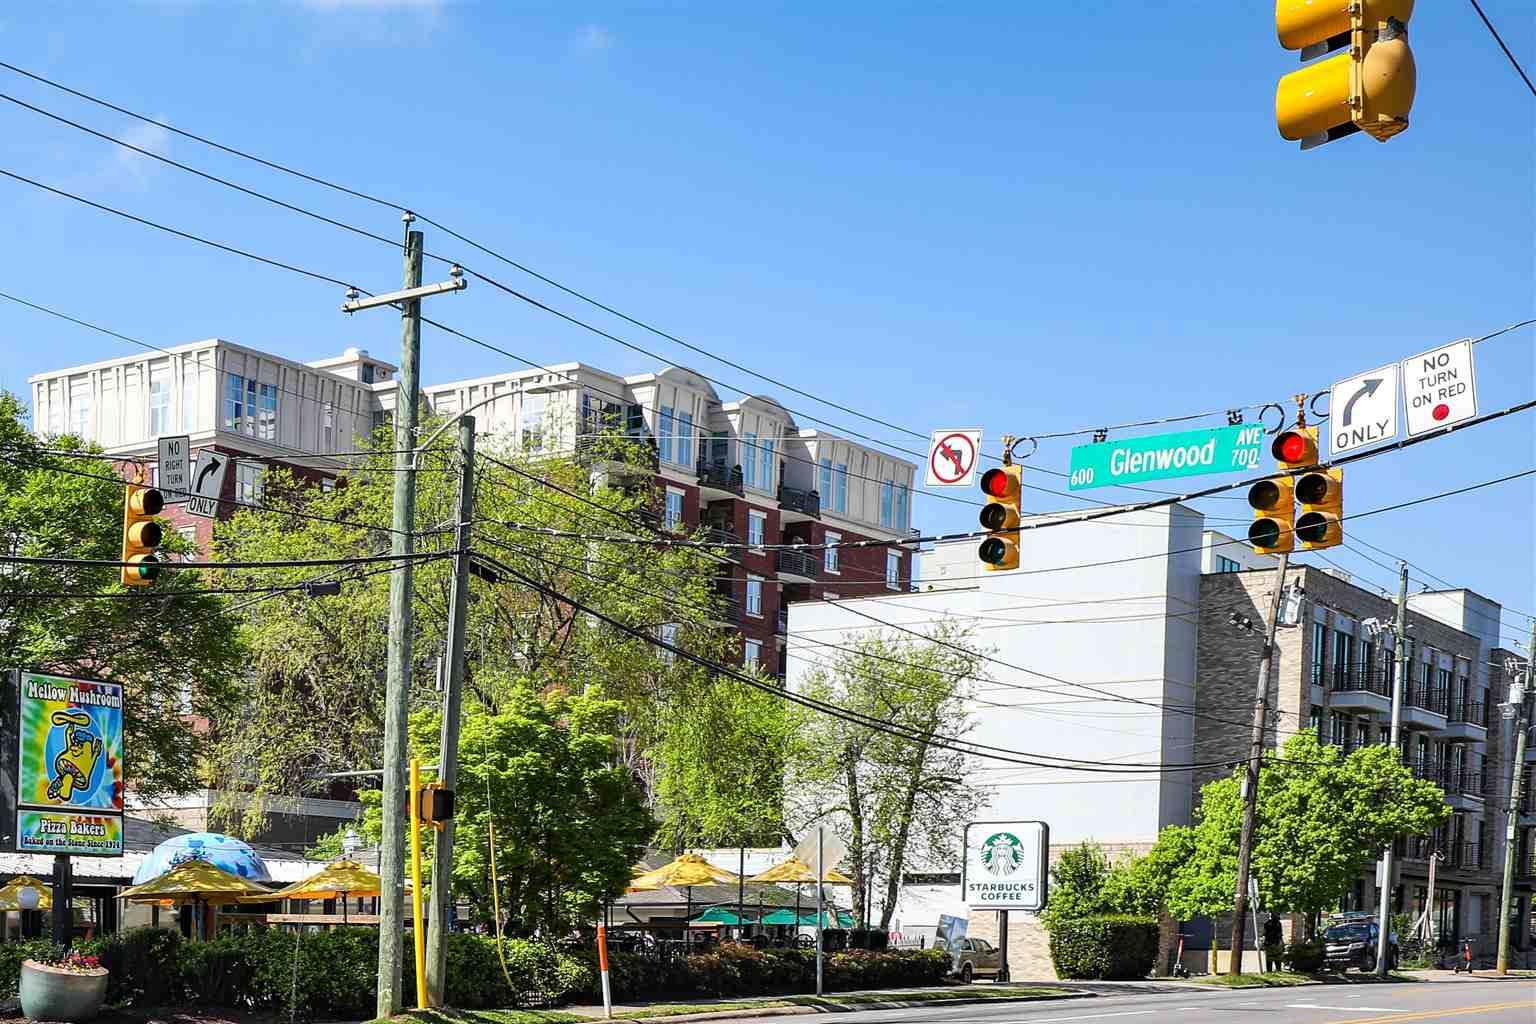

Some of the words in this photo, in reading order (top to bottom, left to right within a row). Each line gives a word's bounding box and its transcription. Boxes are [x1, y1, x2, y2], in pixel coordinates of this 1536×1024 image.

[1423, 353, 1450, 373] NO
[1418, 368, 1458, 389] TURN
[1412, 393, 1432, 408] ON
[1438, 382, 1466, 400] RED
[1336, 419, 1389, 449] ONLY
[168, 441, 180, 456] NO
[1110, 438, 1216, 476] Glenwood
[1236, 427, 1262, 446] AVE
[165, 459, 183, 472] RIGHT
[1070, 467, 1094, 486] 600
[1231, 448, 1259, 467] 700
[166, 473, 183, 484] TURN
[189, 496, 216, 515] ONLY
[28, 681, 66, 700] Mellow
[69, 686, 121, 708] Mushroom
[40, 818, 66, 834] Pizza
[70, 821, 106, 836] Bakers
[24, 836, 44, 845] Baked
[55, 837, 66, 846] the
[88, 839, 104, 848] Since
[969, 883, 1035, 892] STARBUCKS
[980, 892, 1022, 901] COFFEE
